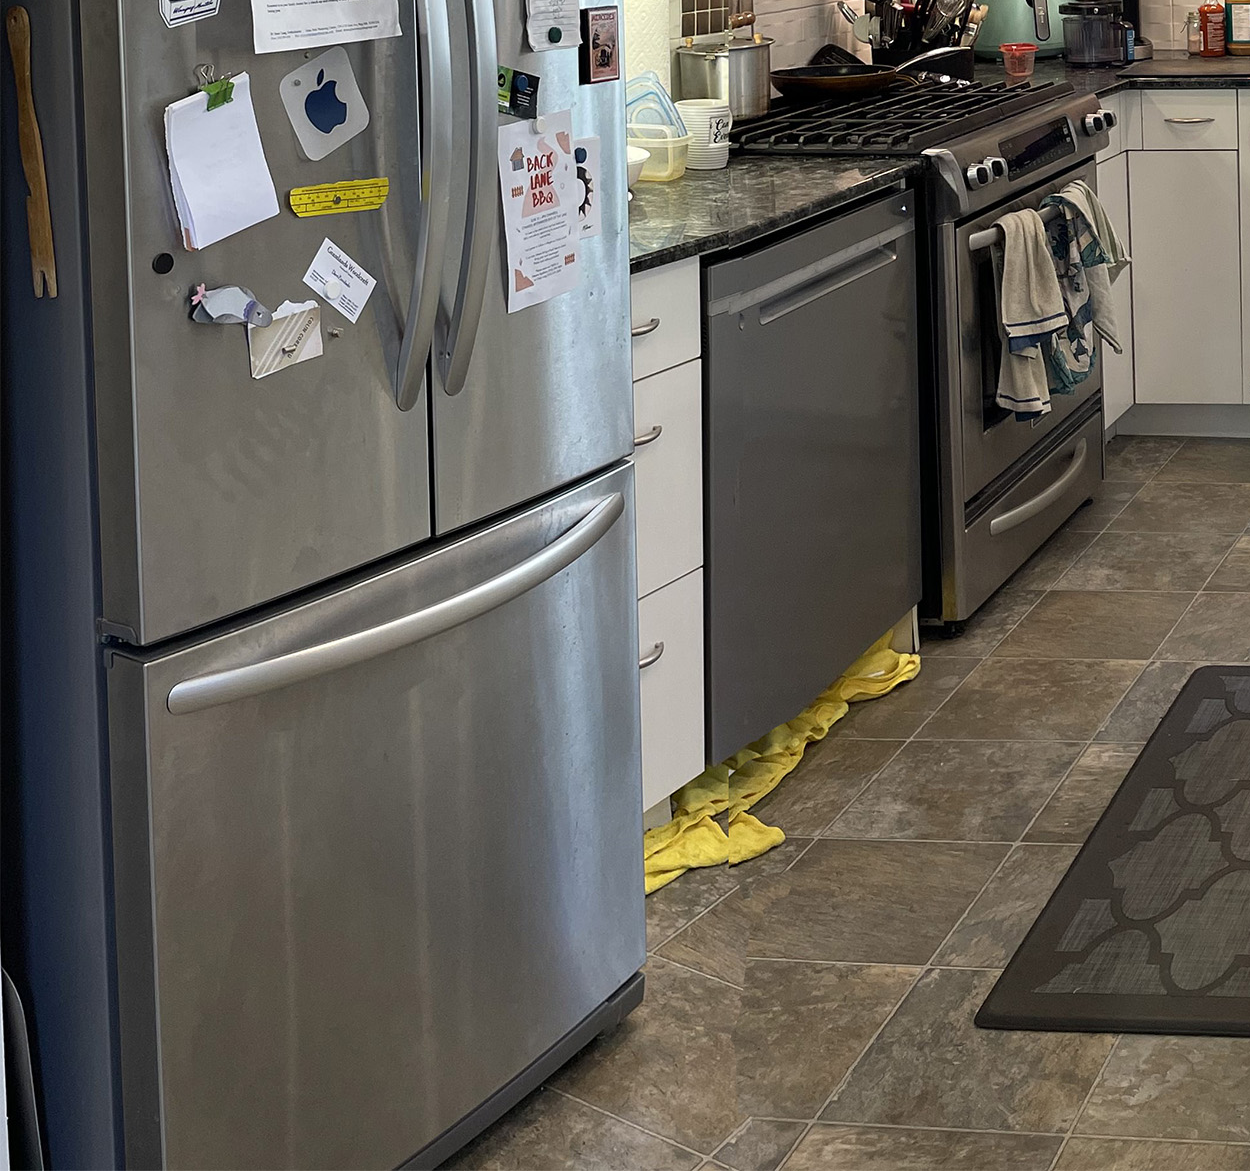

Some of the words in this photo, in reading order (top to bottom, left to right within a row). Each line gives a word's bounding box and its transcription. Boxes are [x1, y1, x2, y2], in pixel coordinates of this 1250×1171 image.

[527, 151, 554, 172] BACK
[530, 170, 554, 190] LANE
[532, 191, 554, 208] BBQ
